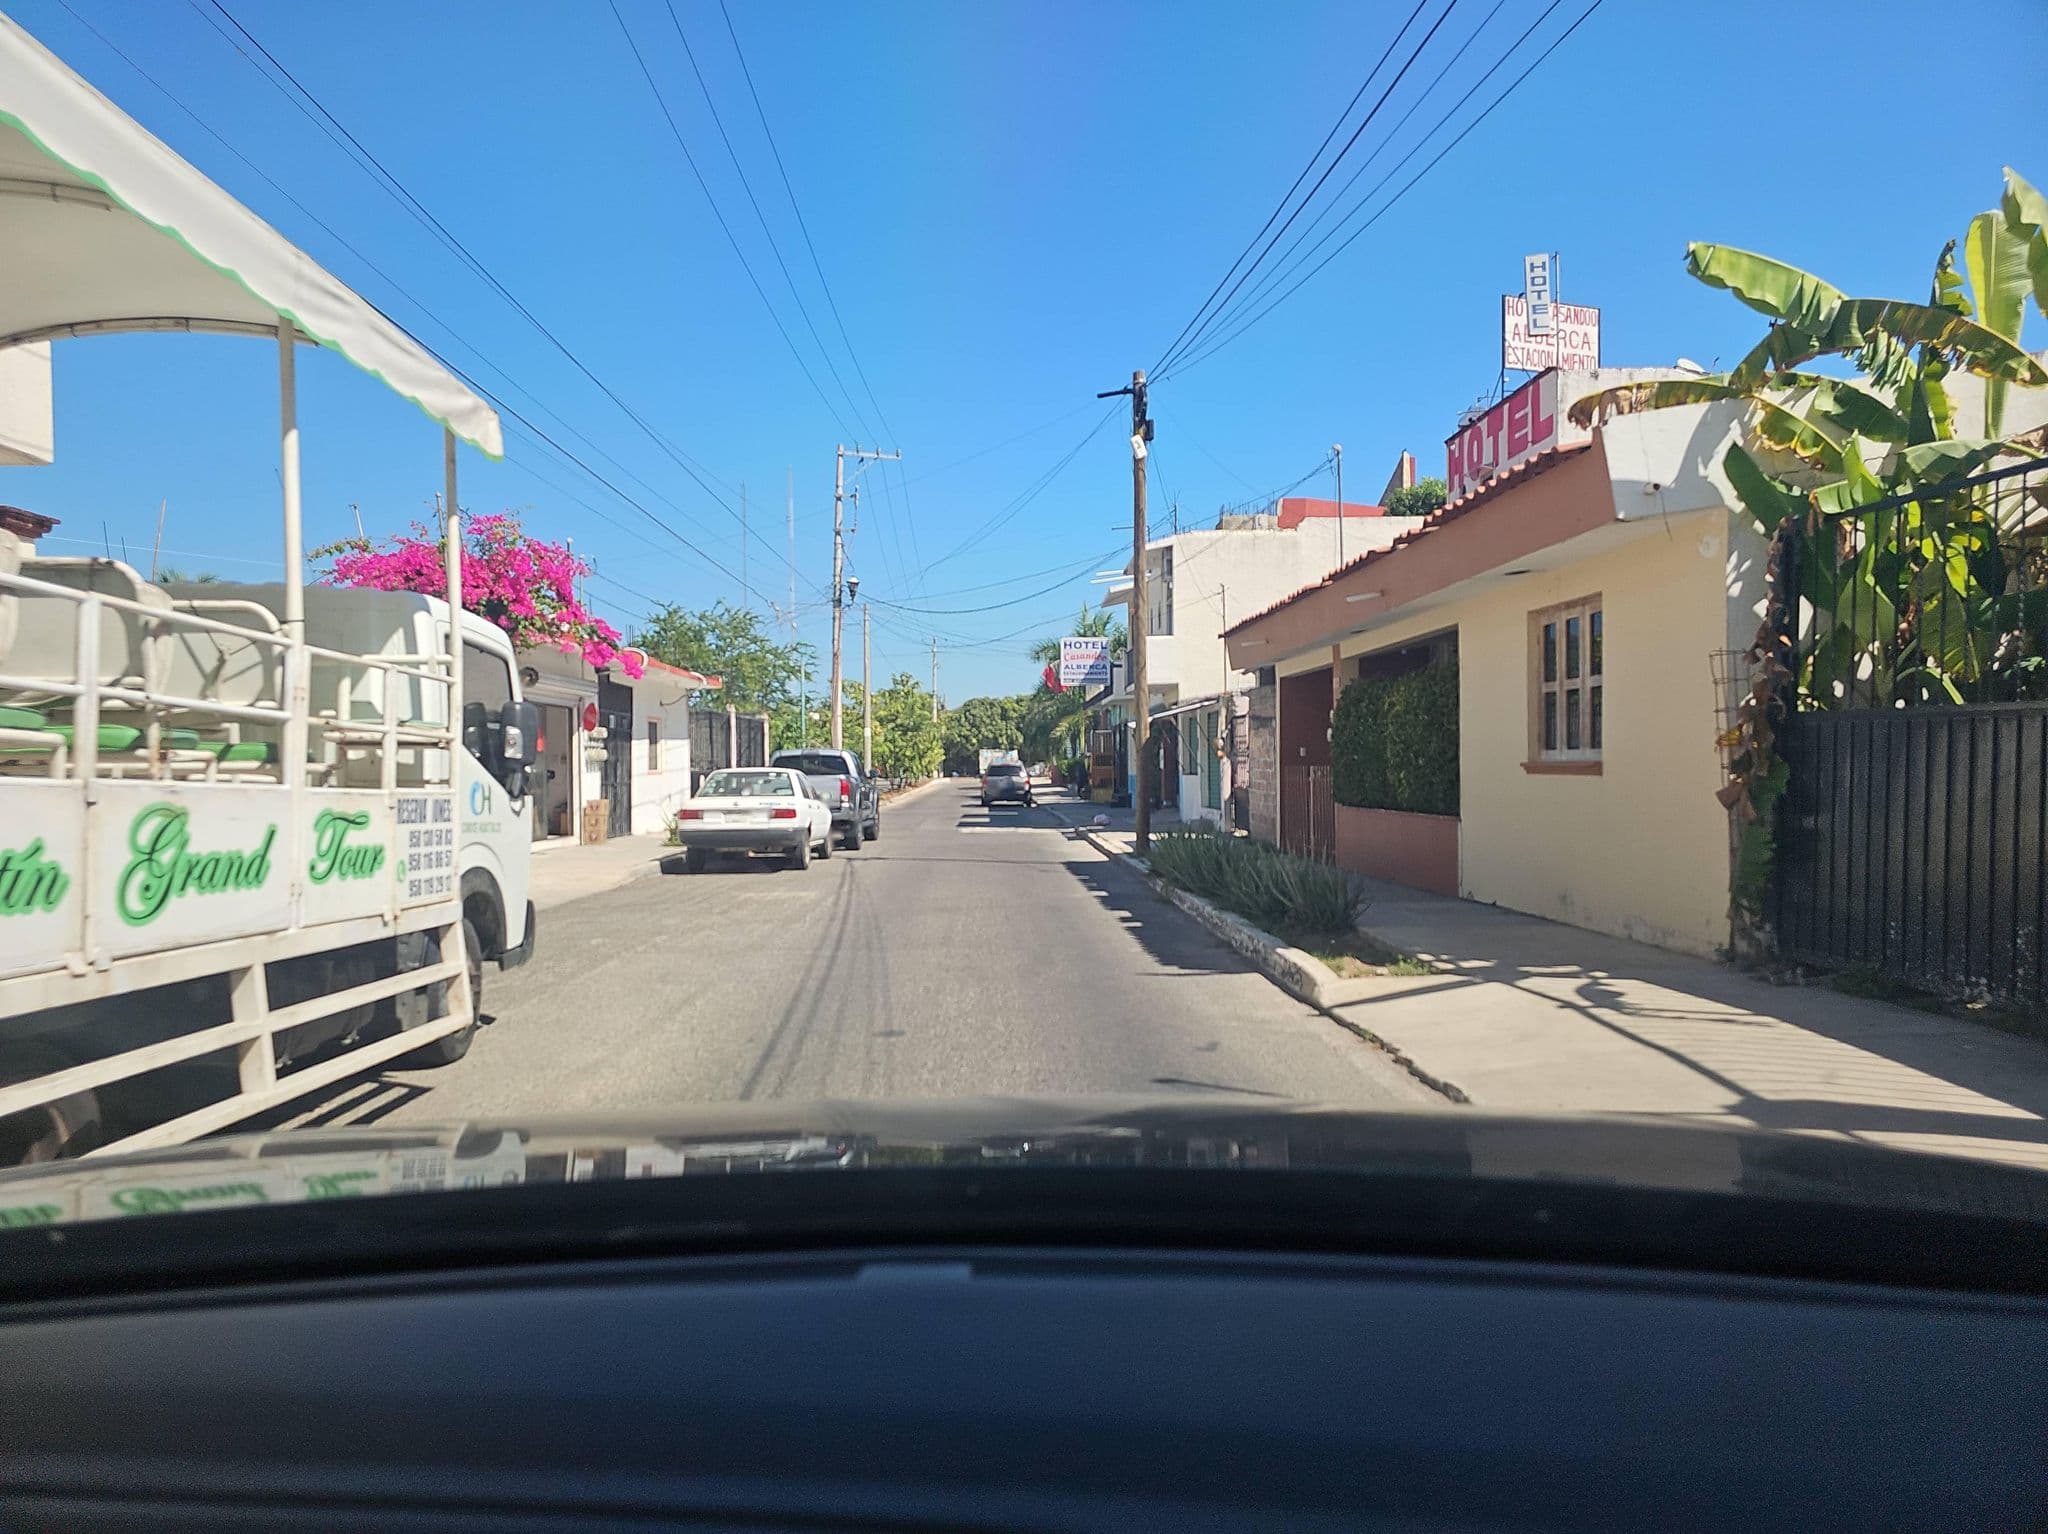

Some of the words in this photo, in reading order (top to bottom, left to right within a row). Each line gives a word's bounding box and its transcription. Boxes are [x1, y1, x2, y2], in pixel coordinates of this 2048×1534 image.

[1530, 260, 1549, 330] HOTEL
[1551, 303, 1597, 328] ASANDOO
[1506, 345, 1597, 370] ESTACIONMIENTO
[1449, 378, 1554, 493] HOTEL
[1063, 641, 1108, 650] HOTEL
[118, 803, 278, 924] Grand
[310, 809, 385, 883] Tour
